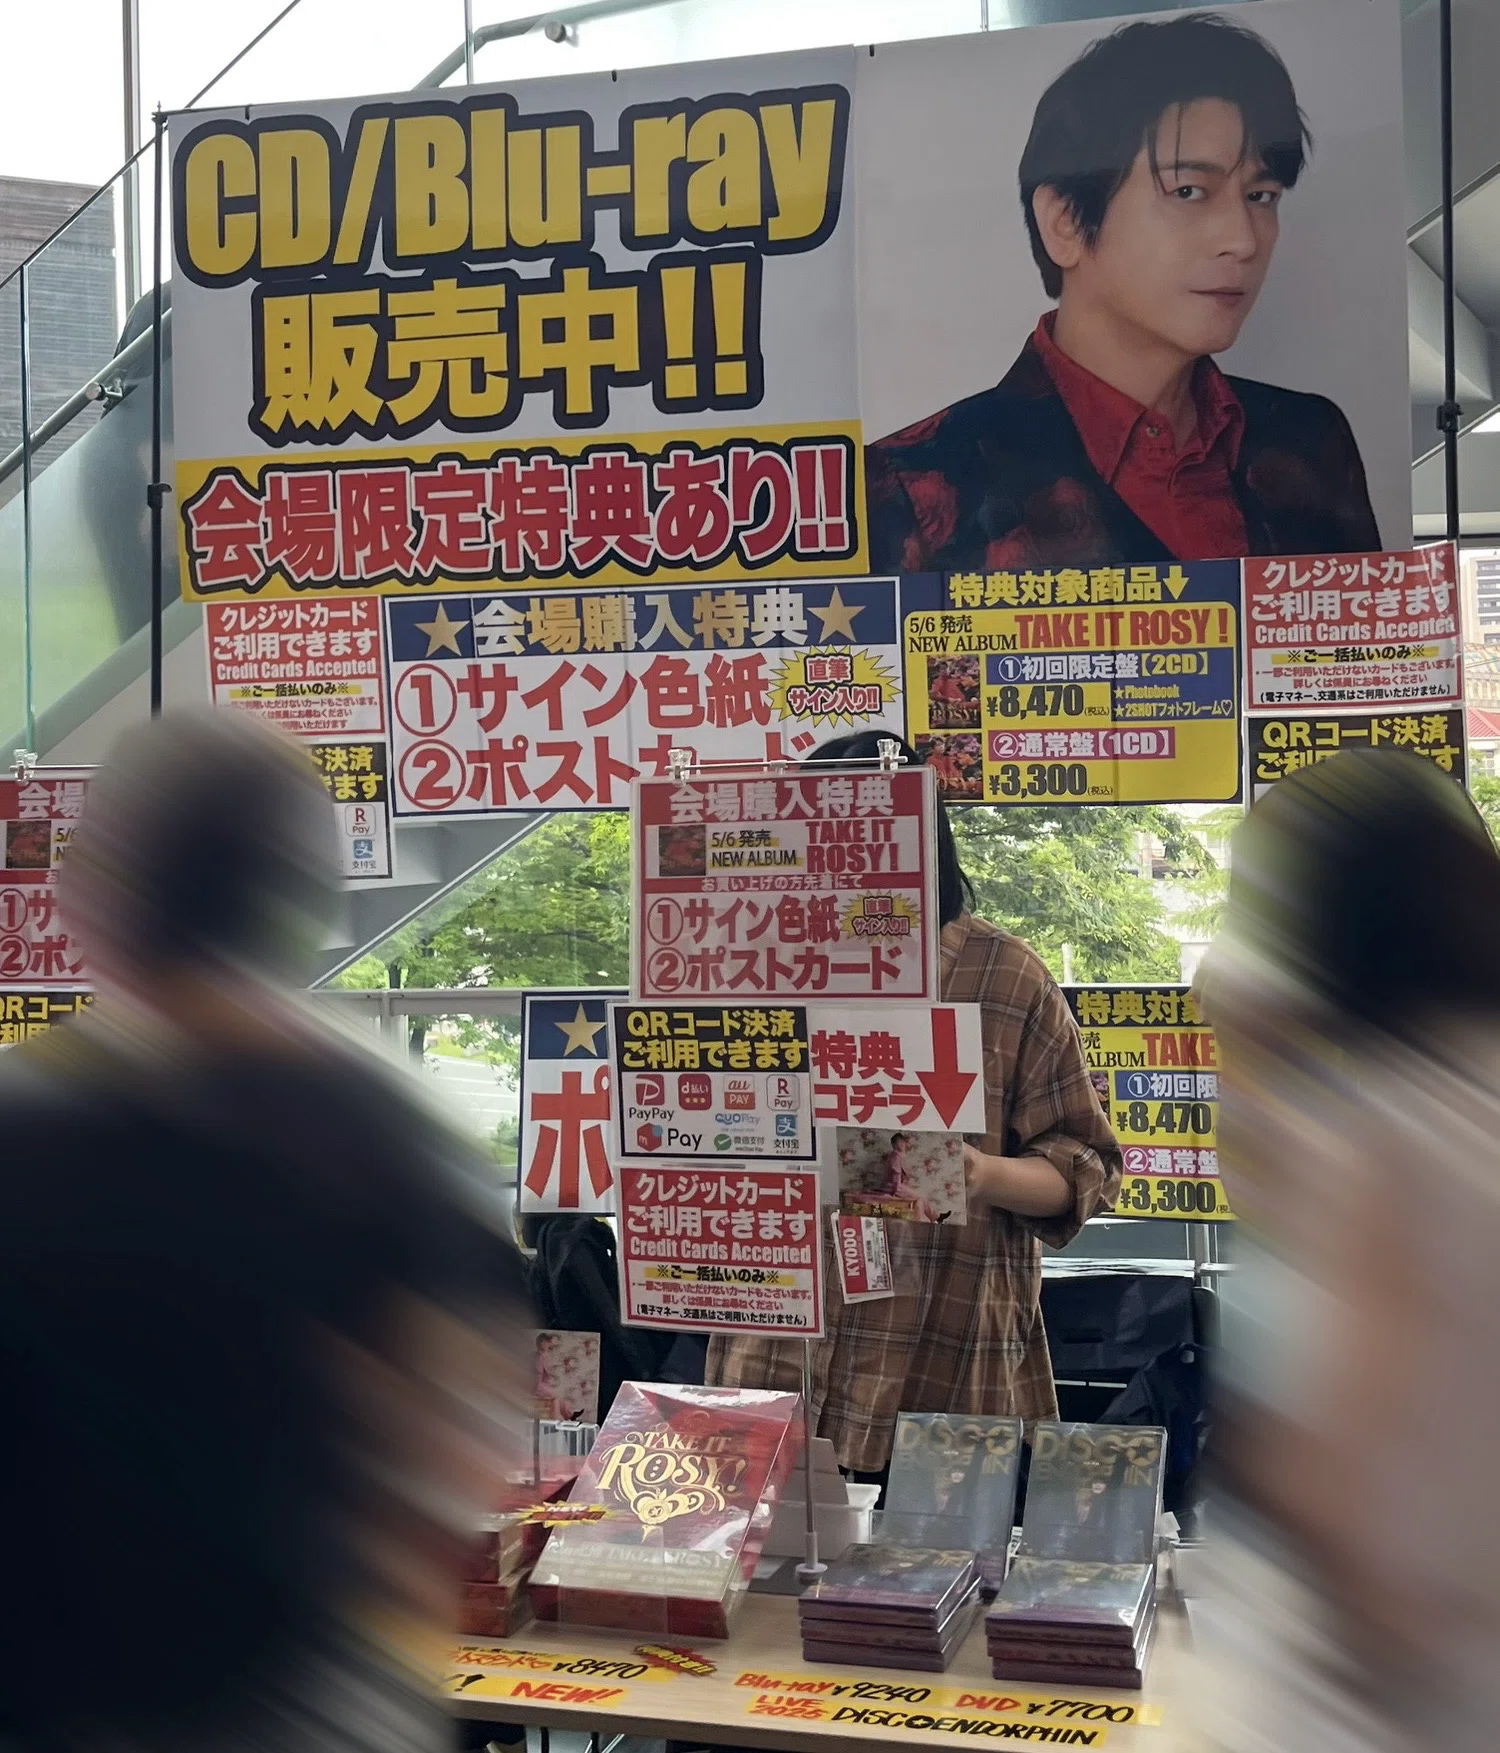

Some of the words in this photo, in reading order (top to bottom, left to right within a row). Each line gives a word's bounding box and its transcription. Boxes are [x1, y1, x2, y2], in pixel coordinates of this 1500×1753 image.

[183, 97, 837, 277] CD/Blu-ray
[260, 260, 748, 435] 販売中!!
[190, 443, 848, 586] 会場限定特典あり!!
[1262, 550, 1445, 589] クレジットカード
[950, 567, 1162, 608] 特典対象商品
[1251, 581, 1454, 622] ご利用できます
[220, 601, 367, 631] クレジットカード
[473, 587, 808, 656] 会場購入特典
[909, 618, 935, 634] 5/6
[940, 615, 972, 633] 発売
[1014, 612, 1089, 649] TAKE
[1095, 610, 1124, 646] IT
[1255, 624, 1312, 644] Credit
[1316, 621, 1371, 642] Cards
[1375, 614, 1455, 639] Accepted
[213, 628, 377, 661] ご利用できます
[909, 636, 950, 653] NEW
[954, 634, 1018, 652] ALBUM
[217, 662, 258, 681] Credit
[261, 660, 303, 679] Cards
[305, 658, 376, 678] Accepted
[807, 657, 850, 682] 直筆
[987, 684, 1084, 720] ¥8,470
[1262, 714, 1448, 749] QRコード決済
[989, 763, 1088, 799] ¥3,300
[669, 776, 894, 823] 会場購入特典
[352, 825, 370, 835] Pay
[711, 831, 735, 848] 5/6
[739, 829, 772, 848] 発売
[805, 820, 865, 844] TAKE
[872, 818, 895, 842] IT
[711, 852, 743, 867] NEW
[748, 850, 797, 866] ALBUM
[627, 1009, 796, 1038] QRコード決済
[622, 1038, 808, 1069] ご利用できます
[810, 1030, 905, 1081] 特典
[1142, 1033, 1217, 1067] TAKE
[728, 1080, 750, 1091] au
[729, 1093, 750, 1104] PAY
[628, 1106, 675, 1122] PayPay
[774, 1098, 793, 1109] Pay
[814, 1082, 926, 1126] コチラ
[1116, 1101, 1212, 1136] ¥8,470
[667, 1127, 703, 1152] Pay
[636, 1173, 804, 1207] クレジットカード
[1120, 1178, 1216, 1214] ¥3,300
[627, 1204, 814, 1242] ご利用できます
[630, 1236, 678, 1259] Credit
[681, 1239, 729, 1261] Cards
[731, 1242, 812, 1265] Accepted
[842, 1227, 860, 1277] KYODO
[638, 1431, 699, 1449] TAKE
[705, 1436, 732, 1452] IT
[595, 1443, 747, 1500] ROSY!
[511, 1681, 624, 1704] NEW!
[734, 1672, 836, 1694] Blu-ray
[831, 1681, 932, 1703] ¥9240
[955, 1693, 1021, 1711] DVD
[1027, 1699, 1135, 1723] ¥7700
[756, 1695, 825, 1708] LIVE
